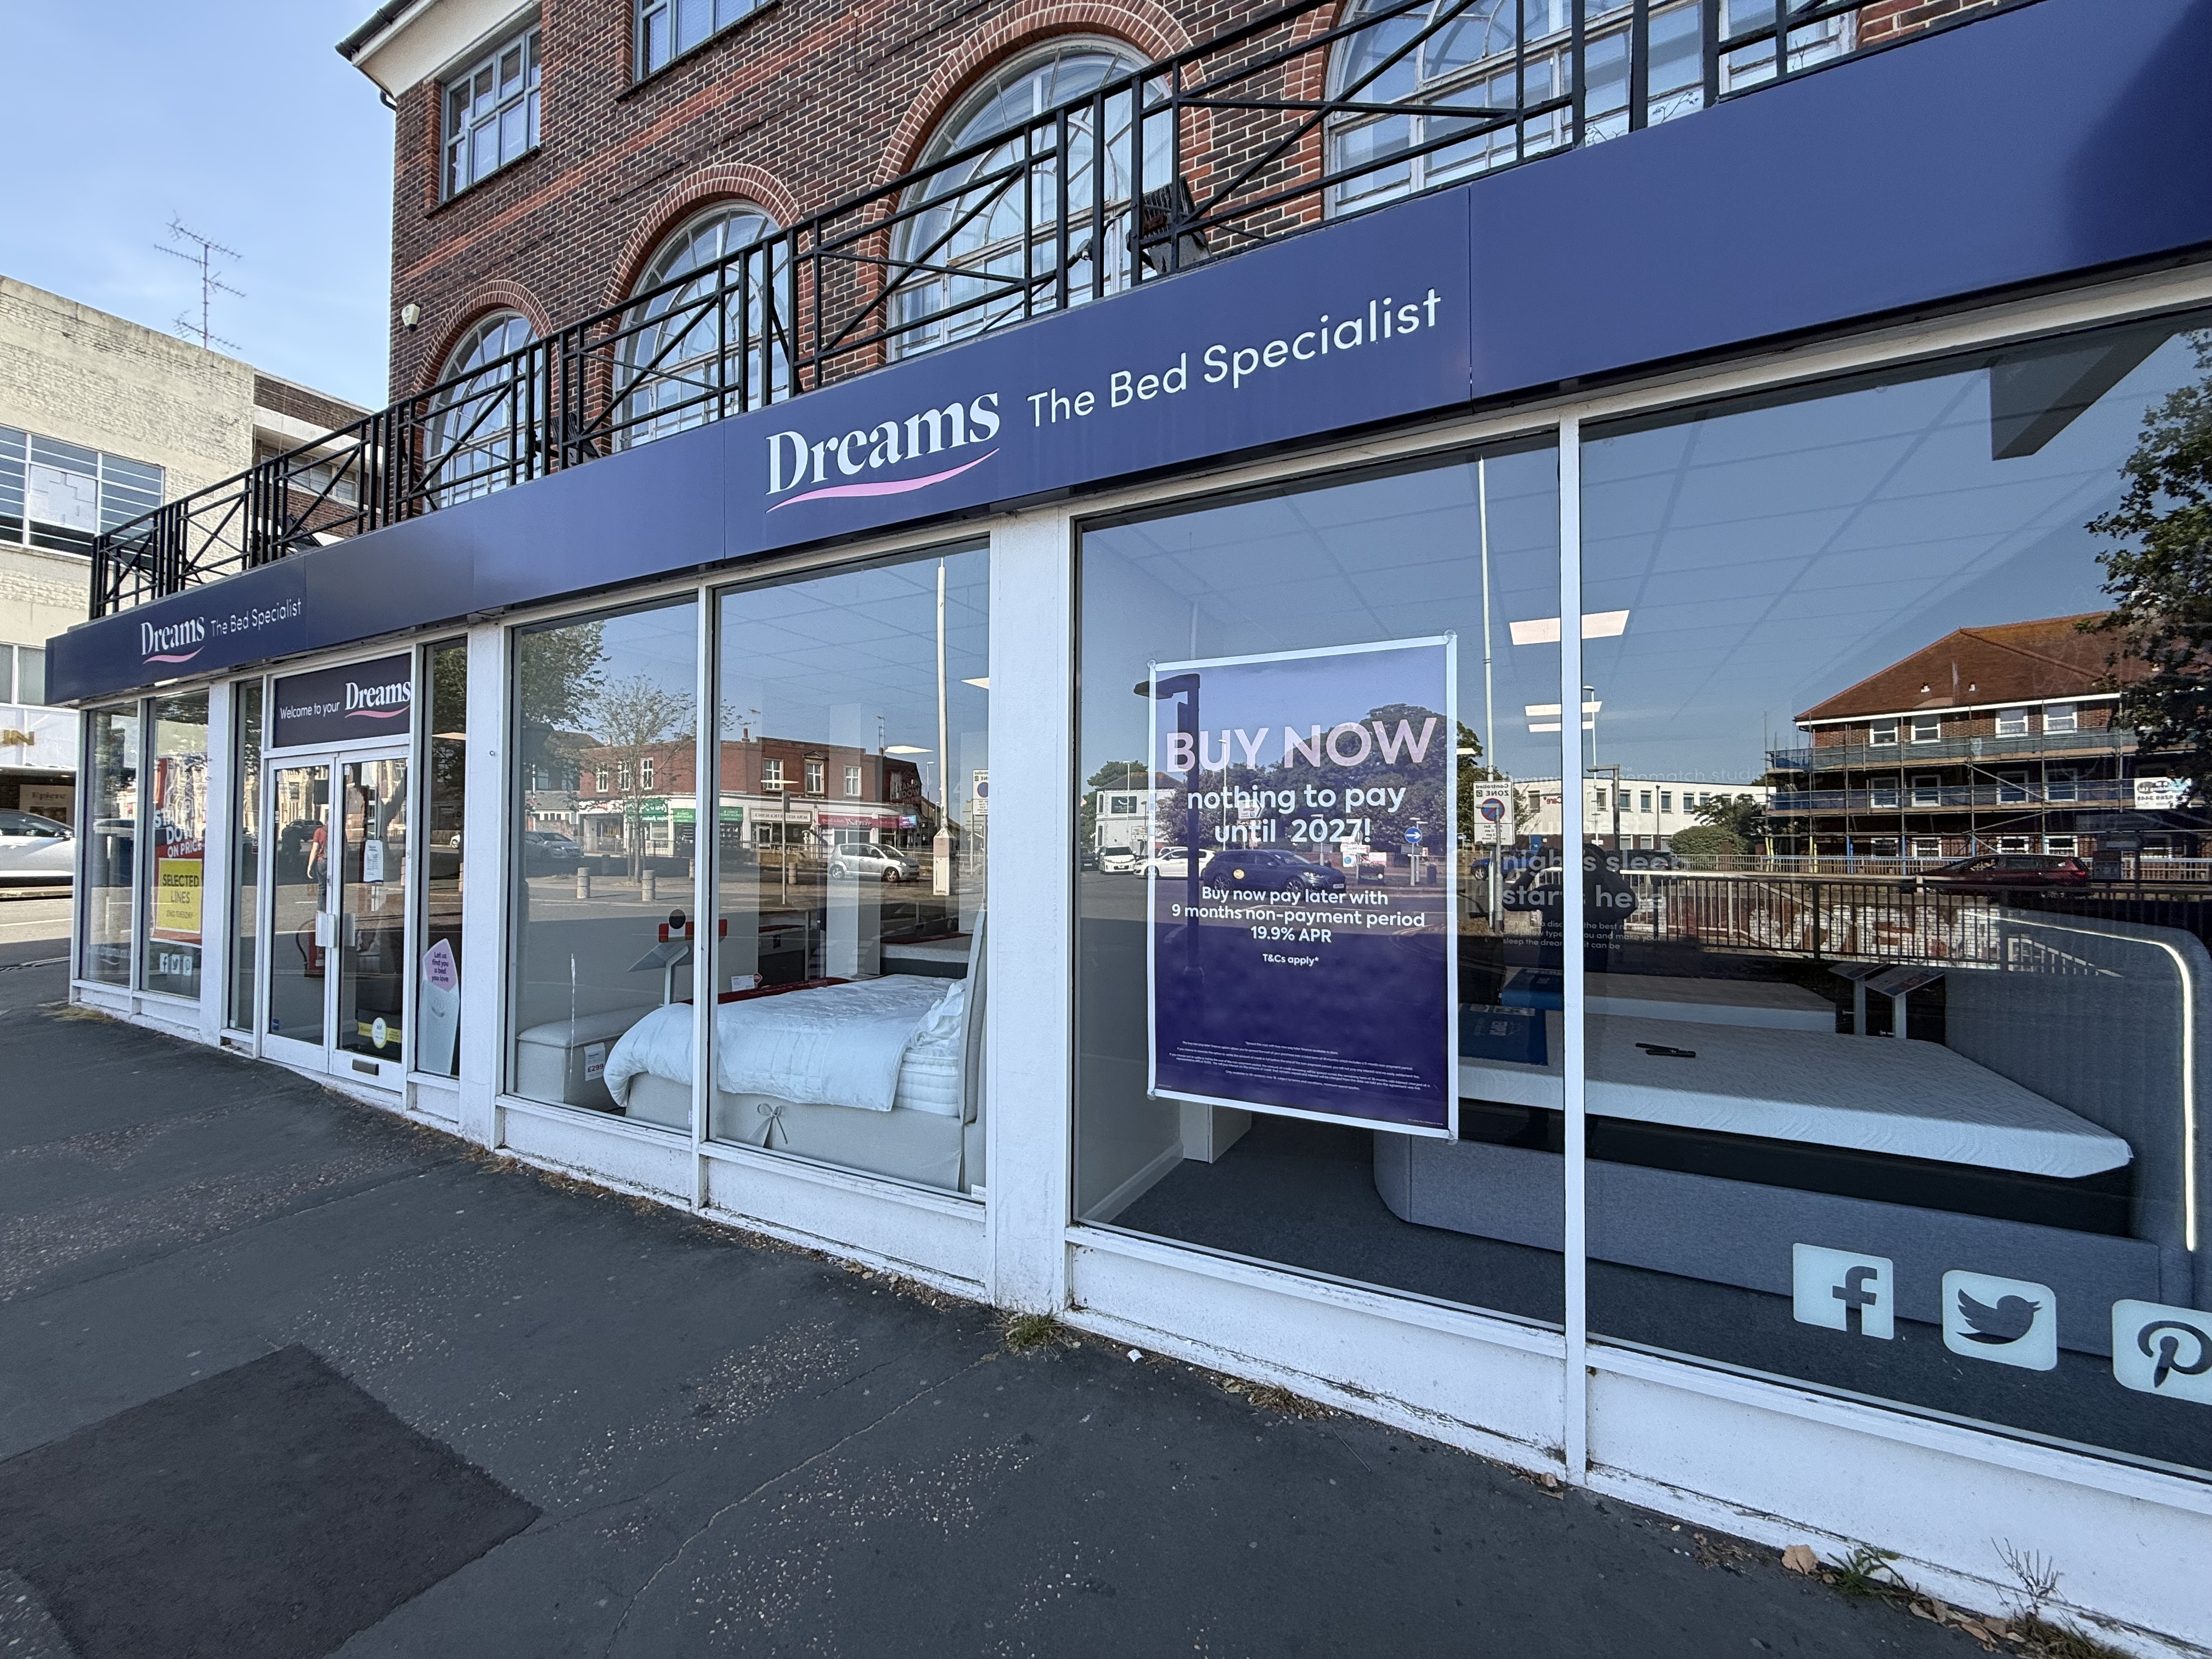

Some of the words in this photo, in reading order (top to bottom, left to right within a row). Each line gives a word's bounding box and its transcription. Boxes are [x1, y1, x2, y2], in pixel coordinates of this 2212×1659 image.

[1027, 387, 1095, 427] The
[1110, 352, 1187, 408] Bed
[1204, 288, 1441, 388] Specialist
[765, 392, 1000, 495] Dreams
[211, 619, 228, 637] The
[230, 610, 249, 633] Bed
[252, 597, 301, 630] Specialist
[141, 617, 205, 655] Dreams
[280, 706, 312, 719] Welcome
[314, 703, 321, 714] to
[323, 701, 340, 717] your
[345, 681, 411, 710] Dreams
[1166, 727, 1268, 772] BUY
[1284, 717, 1437, 768] NOW
[1188, 785, 1295, 814] nothing
[1304, 785, 1336, 808] to
[1345, 787, 1406, 813] pay
[1215, 820, 1276, 843] until
[1291, 819, 1370, 843] 2027!
[167, 844, 179, 857] ON
[1503, 849, 1596, 877] nighs
[162, 873, 199, 887] SELECTED
[171, 890, 190, 904] LINES
[1202, 886, 1228, 904] Buy
[1233, 889, 1266, 901] now
[1270, 891, 1301, 906] pay
[1305, 889, 1347, 904] later
[1349, 890, 1389, 905] with
[1171, 904, 1181, 917] 9
[1184, 906, 1242, 919] months
[1245, 909, 1362, 926] non-payment
[1366, 911, 1425, 928] period
[1599, 922, 1617, 930] best
[1251, 926, 1295, 941] 19.9%
[1299, 928, 1332, 943] APR
[1503, 938, 1523, 946] sleep
[1596, 930, 1613, 940] and
[1643, 934, 1661, 943] your
[1262, 953, 1286, 963] T&Cs
[588, 1063, 603, 1073] £299
